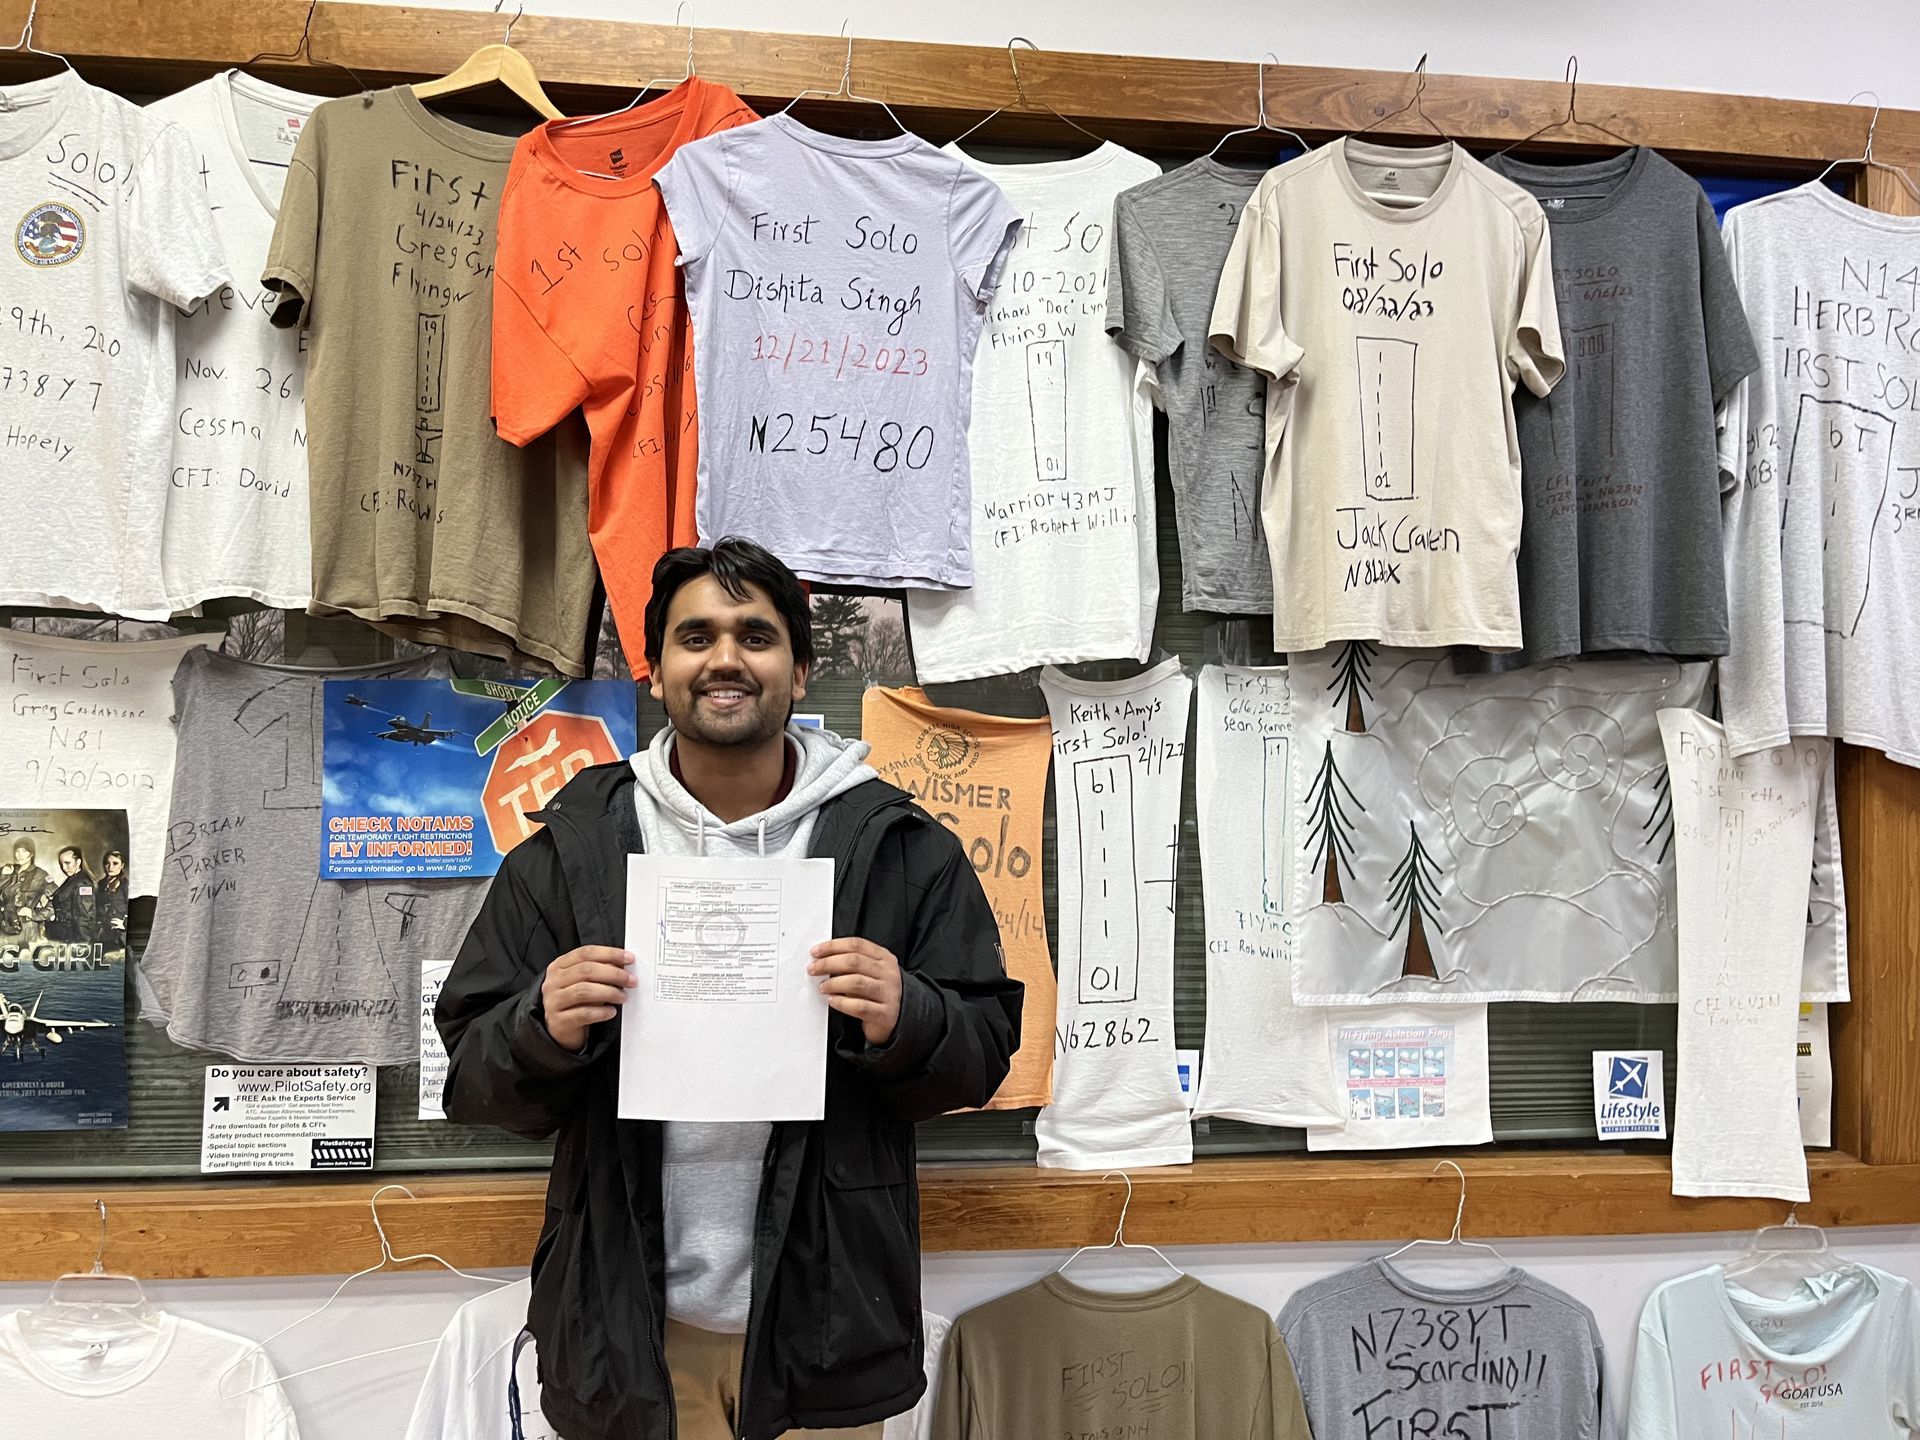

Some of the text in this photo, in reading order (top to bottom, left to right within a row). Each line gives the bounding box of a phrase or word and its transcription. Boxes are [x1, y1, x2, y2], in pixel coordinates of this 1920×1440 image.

[391, 160, 490, 212] First
[416, 203, 485, 246] 4/24/23
[750, 212, 918, 254] First Solo
[395, 224, 457, 269] Greg
[1333, 242, 1445, 288] First Solo
[723, 269, 922, 336] Dishita Singh
[1342, 284, 1435, 322] 08/22/23
[1794, 285, 1876, 336] HERB
[991, 321, 1077, 350] Flying W
[185, 358, 228, 380] Nov.
[750, 332, 929, 380] 12/21/2023
[179, 408, 262, 441] Cessna
[6, 425, 75, 462] Hopely
[749, 412, 934, 473] N25480
[239, 468, 291, 498] David
[1375, 471, 1391, 488] 01
[984, 493, 1056, 521] Warrior
[1030, 518, 1080, 535] Robert
[1335, 507, 1460, 554] Jack Craven
[12, 653, 131, 689] First Solo
[1224, 672, 1279, 695] First
[484, 682, 518, 700] SHORT
[13, 693, 58, 721] Greg
[503, 691, 541, 730] NOTICE
[1070, 697, 1163, 725] Keith Amy's
[942, 722, 961, 731] HIGH
[1102, 720, 1147, 750] Solo!
[1223, 715, 1254, 732] Sean
[1680, 731, 1729, 761] First
[26, 756, 154, 792] 9/20/2012
[931, 771, 952, 780] TRACK
[954, 768, 968, 779] AND
[967, 751, 980, 769] FIELD
[895, 772, 1012, 811] WISMER
[164, 816, 246, 859] BRIAN
[328, 815, 474, 833] CHECK NOTAMS
[347, 833, 392, 841] TEMPORARY
[393, 833, 419, 841] FLIGHT
[420, 832, 473, 840] RESTRICTIONS
[328, 840, 473, 858] FLY INFORMED!
[172, 847, 246, 881] PARKER
[329, 865, 342, 873] For
[364, 865, 405, 873] information
[406, 866, 416, 874] go
[32, 942, 112, 972] GIRL
[1239, 939, 1256, 955] Rob
[1090, 965, 1119, 991] 01
[1728, 994, 1782, 1011] KEVIN
[422, 1022, 432, 1032] At
[1384, 1029, 1426, 1040] Aviation
[422, 1037, 437, 1047] top
[211, 1067, 369, 1080] Do you care about safety?
[237, 1080, 372, 1093] www.PilotSafety.org
[261, 1094, 277, 1102] Ask
[278, 1094, 292, 1102] the
[293, 1094, 324, 1103] Experts
[326, 1093, 357, 1102] Service
[1600, 1101, 1660, 1122] LifeStyle
[228, 1122, 267, 1130] downloads
[280, 1122, 300, 1130] pilots
[234, 1132, 263, 1140] product
[232, 1151, 260, 1160] training
[260, 1151, 294, 1159] programs
[238, 1142, 254, 1150] topic
[253, 1160, 266, 1168] tips
[1352, 1304, 1531, 1374] N738YT
[1061, 1350, 1136, 1394] FIRST
[1700, 1358, 1775, 1391] FIRST
[1781, 1383, 1844, 1400] GOAT USA
[1352, 1388, 1521, 1440] FIRST
